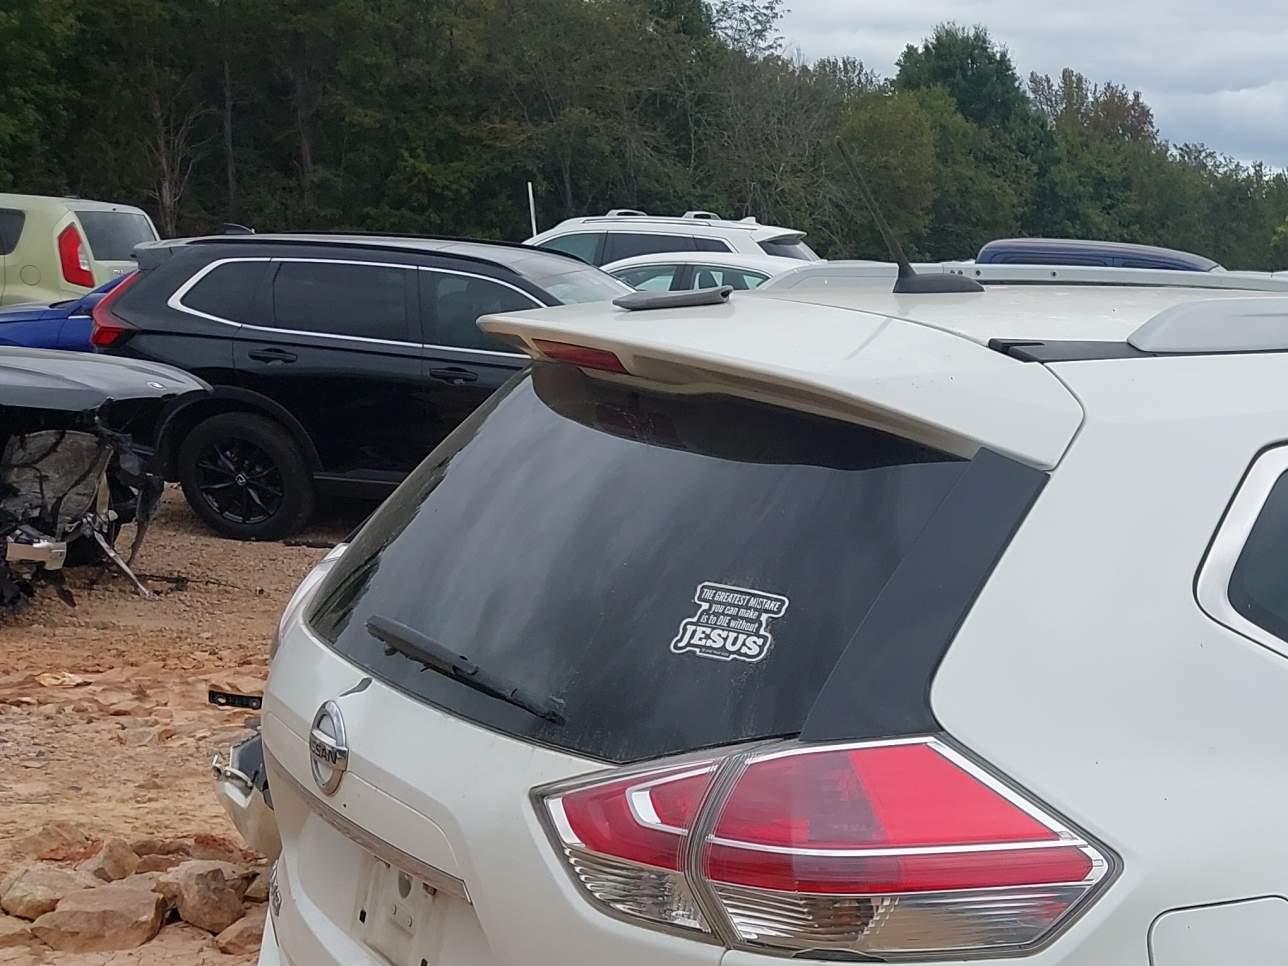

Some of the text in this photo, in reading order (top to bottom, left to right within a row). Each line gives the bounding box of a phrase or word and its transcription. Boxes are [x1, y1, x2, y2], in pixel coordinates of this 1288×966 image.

[702, 588, 781, 611] THE GREATEST MISTAKE
[700, 612, 759, 633] is to DIE without
[710, 604, 759, 619] you can make
[677, 625, 764, 655] JESUS
